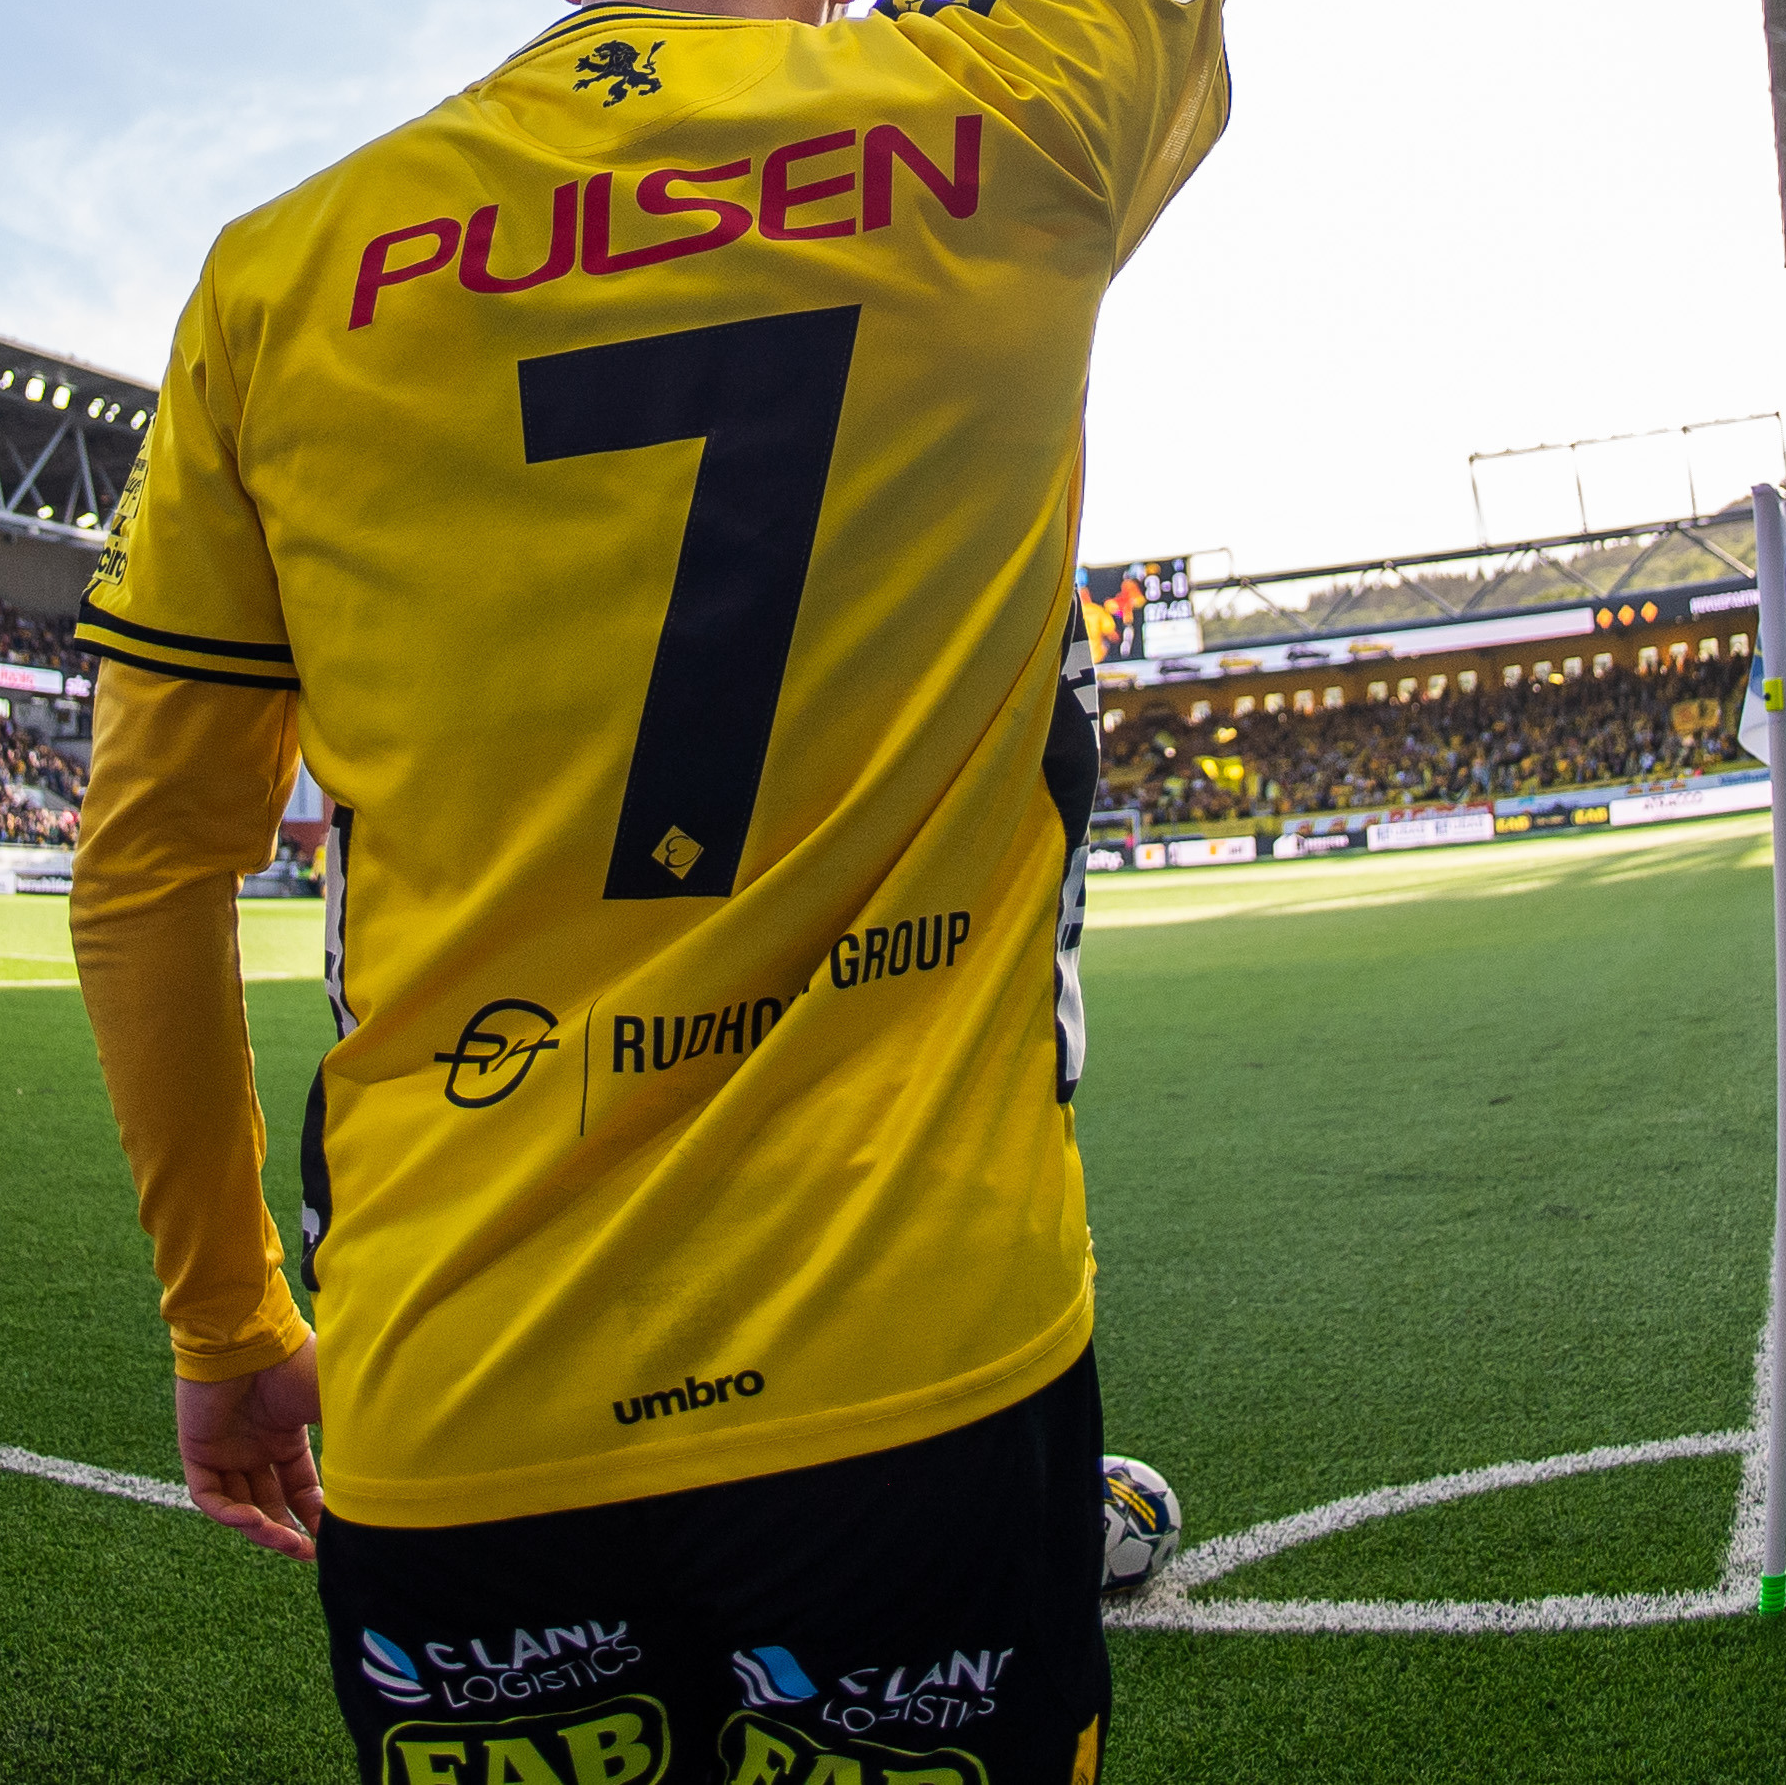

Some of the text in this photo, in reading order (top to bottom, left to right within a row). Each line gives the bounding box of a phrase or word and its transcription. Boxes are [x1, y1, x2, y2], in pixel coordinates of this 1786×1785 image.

[348, 114, 983, 332] PULSEN
[517, 304, 862, 900] 7
[829, 910, 971, 989] GROUP
[612, 1369, 765, 1425] umbro
[426, 1639, 466, 1670] C
[442, 1633, 642, 1709] LOGISTICS
